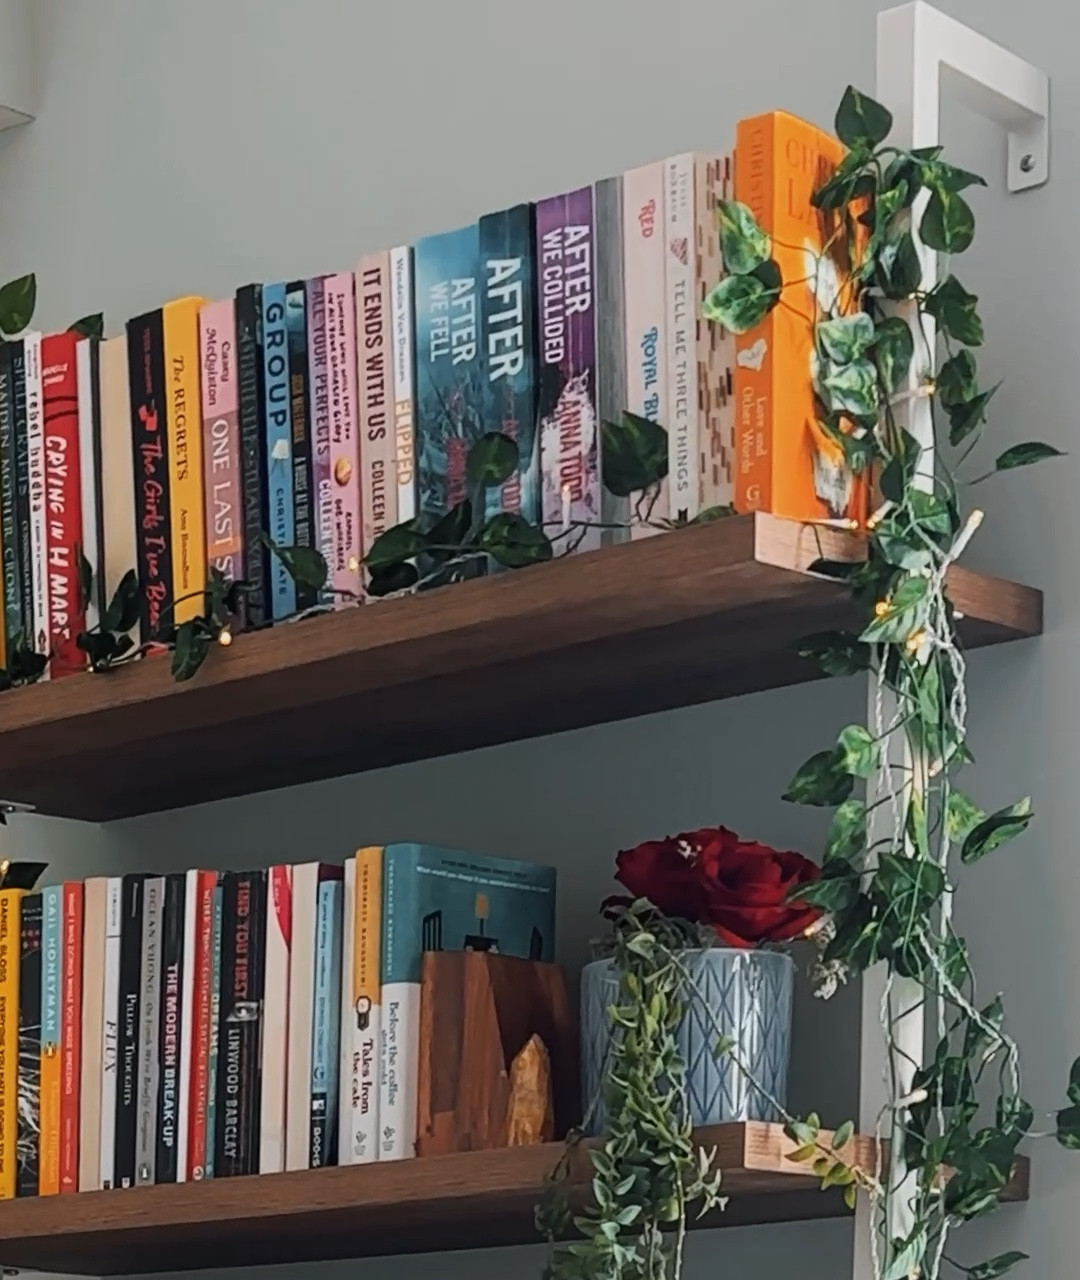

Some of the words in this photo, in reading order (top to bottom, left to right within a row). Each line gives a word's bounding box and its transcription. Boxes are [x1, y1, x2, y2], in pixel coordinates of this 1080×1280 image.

[639, 200, 655, 238] RED
[542, 229, 562, 264] WE
[564, 225, 591, 316] AFTER
[363, 269, 380, 286] IT
[429, 281, 449, 314] WE
[674, 280, 689, 323] TELL
[312, 291, 328, 324] ALL
[364, 294, 383, 349] ENDS
[450, 278, 477, 365] AFTER
[485, 257, 524, 382] AFTER
[543, 267, 564, 363] COLLIDED
[266, 303, 287, 427] GROUP
[314, 328, 329, 368] YOUR
[429, 318, 450, 362] FELL
[640, 328, 658, 389] ROYAL
[675, 330, 688, 356] ME
[172, 356, 184, 382] The
[367, 352, 384, 406] WITH
[676, 362, 689, 422] THREE
[174, 390, 188, 481] REGRETS
[316, 373, 329, 455] PERFECTS
[368, 413, 385, 441] US
[559, 399, 581, 453] ANNA
[141, 438, 163, 472] The
[212, 419, 230, 474] ONE
[396, 400, 412, 485] FLIPPED
[677, 426, 690, 492] THINGS
[1, 459, 13, 536] MOTHER
[46, 436, 68, 514] CRYING
[372, 460, 385, 521] COLLEEN
[560, 454, 585, 502] TODD
[51, 521, 65, 539] IN
[143, 480, 163, 528] Girls
[214, 481, 233, 546] LAST
[319, 480, 331, 549] COLLEEN
[50, 547, 69, 567] H
[51, 574, 69, 638] MART
[47, 894, 57, 930] GAIL
[46, 937, 56, 1031] HONEYMAN
[166, 964, 178, 994] THE
[104, 1020, 117, 1074] FLUX
[165, 996, 178, 1065] MODERN
[388, 1002, 399, 1041] Before
[227, 1029, 239, 1093] LINWOOD
[361, 1039, 373, 1077] Tales
[388, 1046, 398, 1066] the
[163, 1069, 176, 1146] BREAK-UP
[361, 1082, 372, 1114] from
[388, 1069, 398, 1106] coffee
[225, 1099, 238, 1158] BARCLAY
